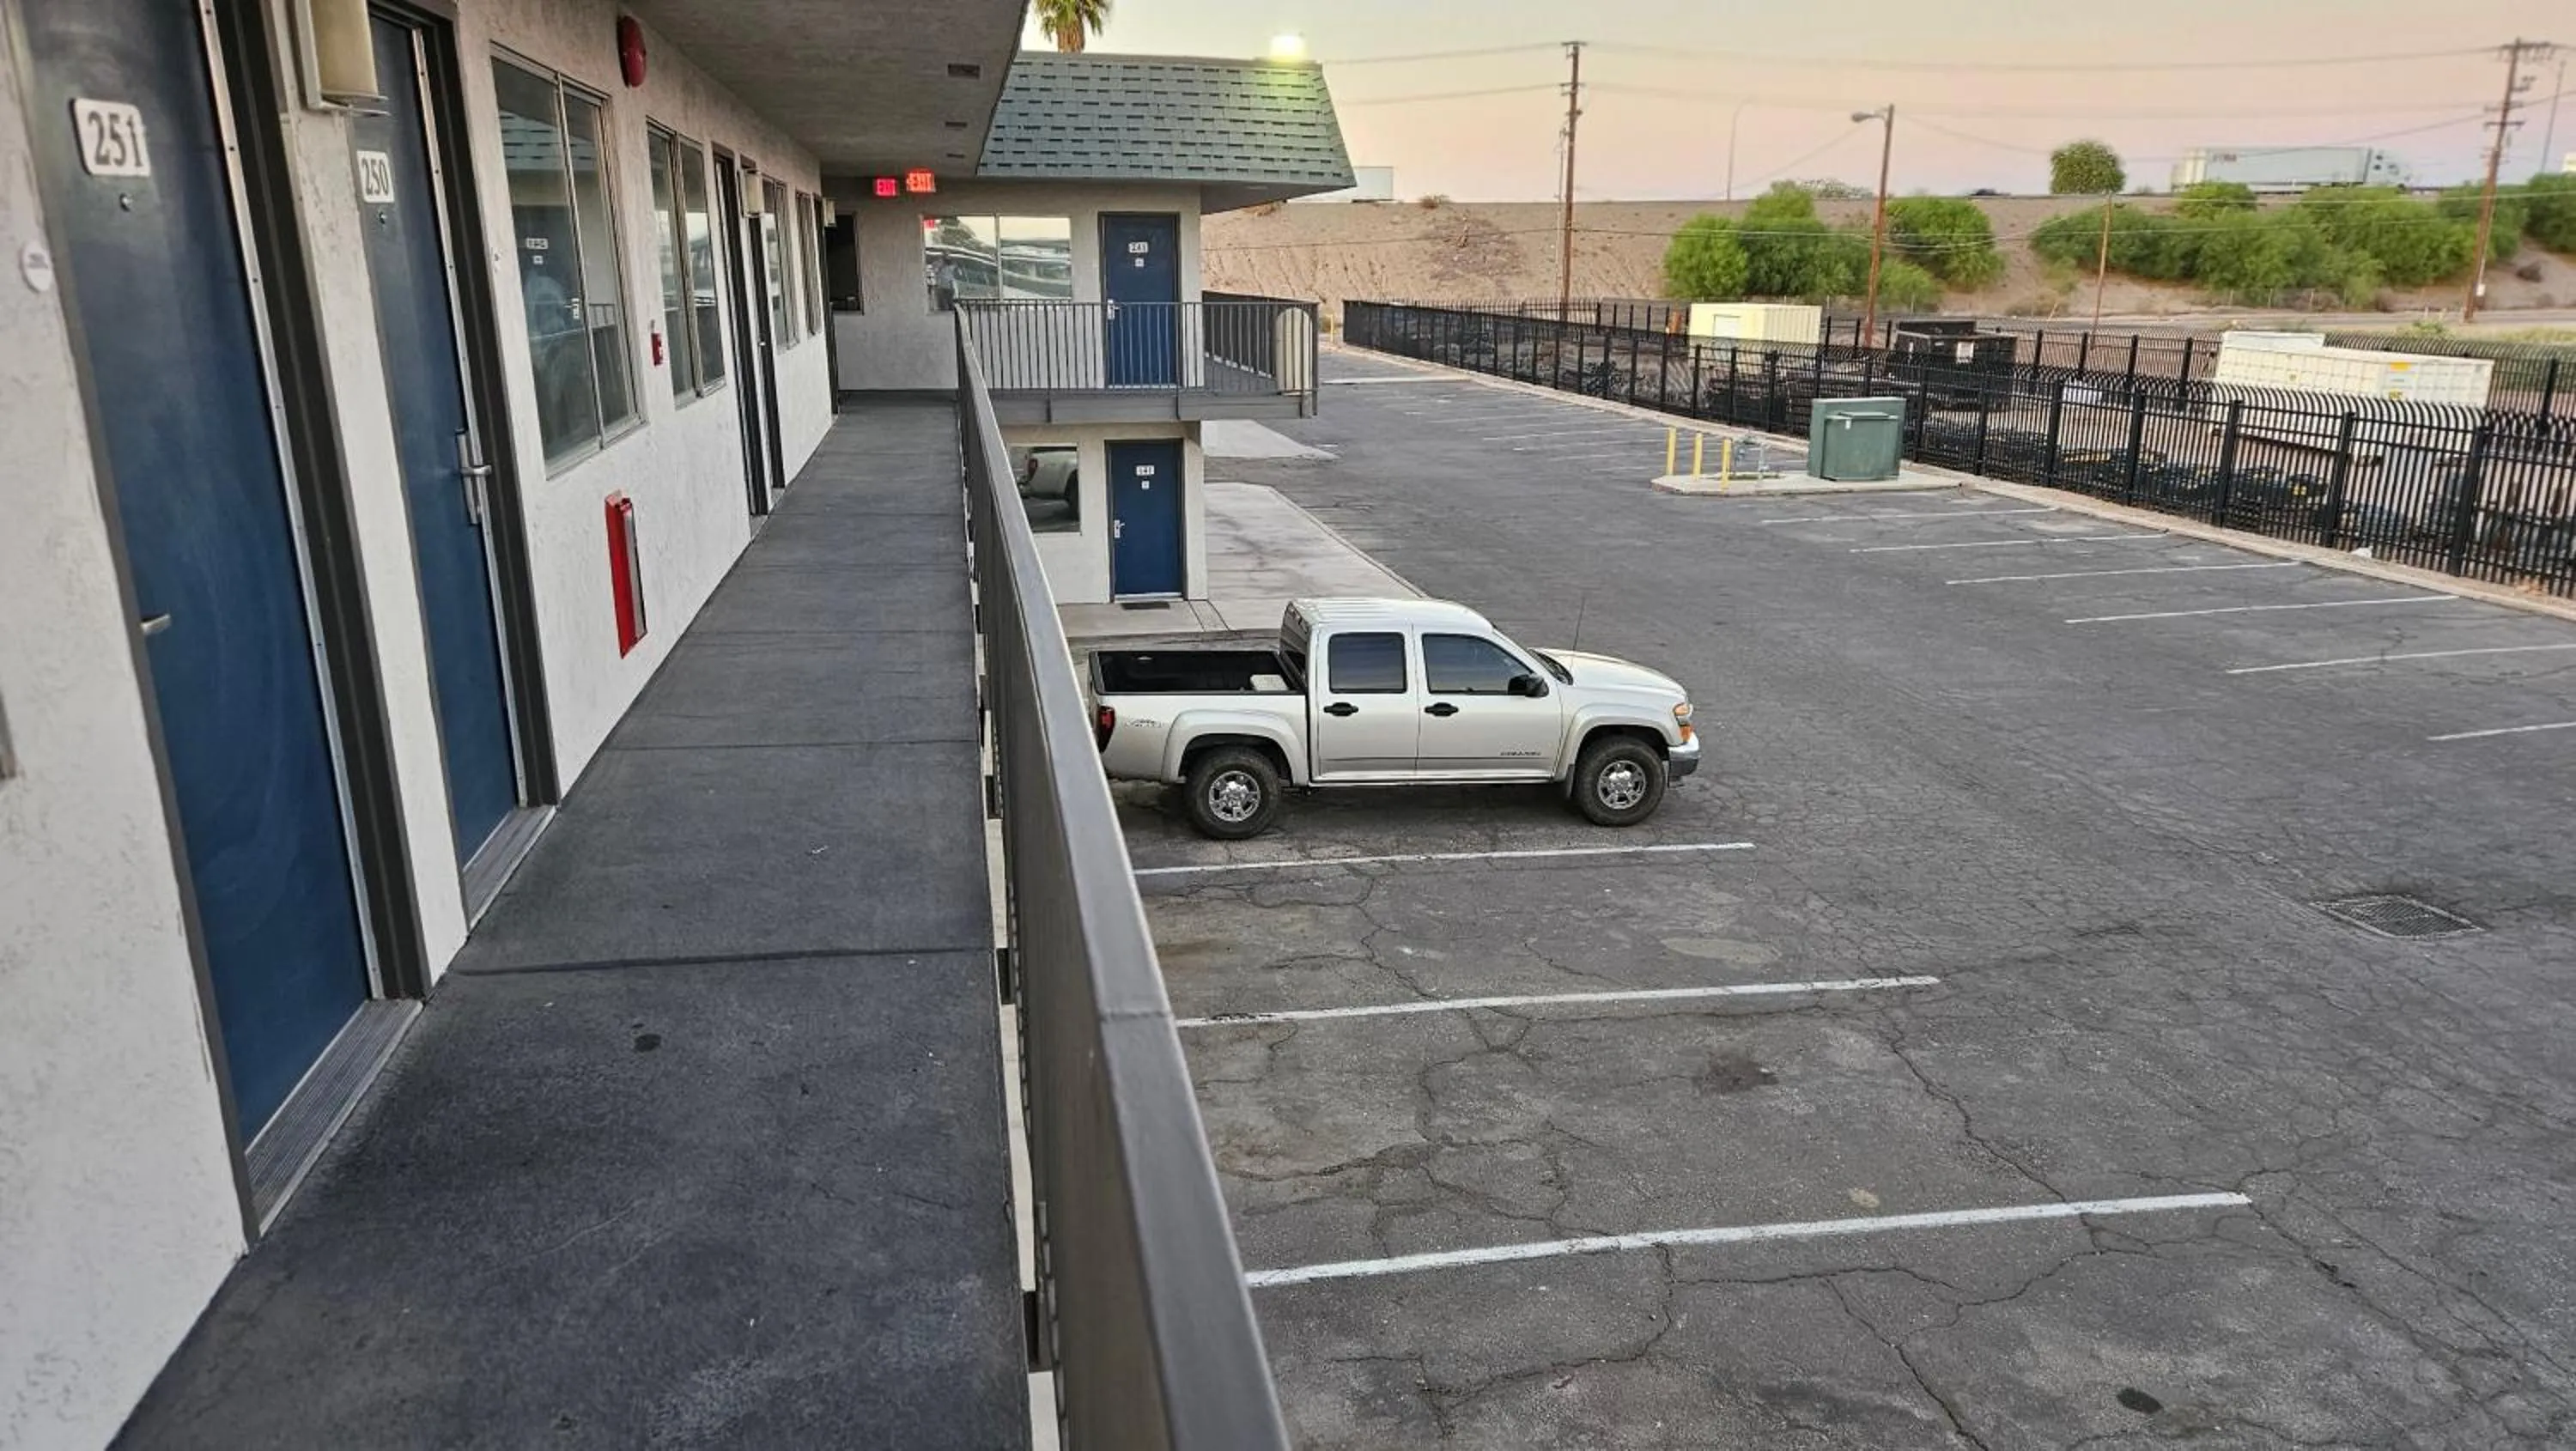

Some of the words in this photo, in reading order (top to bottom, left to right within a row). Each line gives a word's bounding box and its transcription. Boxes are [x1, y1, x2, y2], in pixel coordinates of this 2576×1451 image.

[87, 111, 143, 167] 251
[361, 158, 389, 196] 250
[909, 173, 933, 192] EXIT
